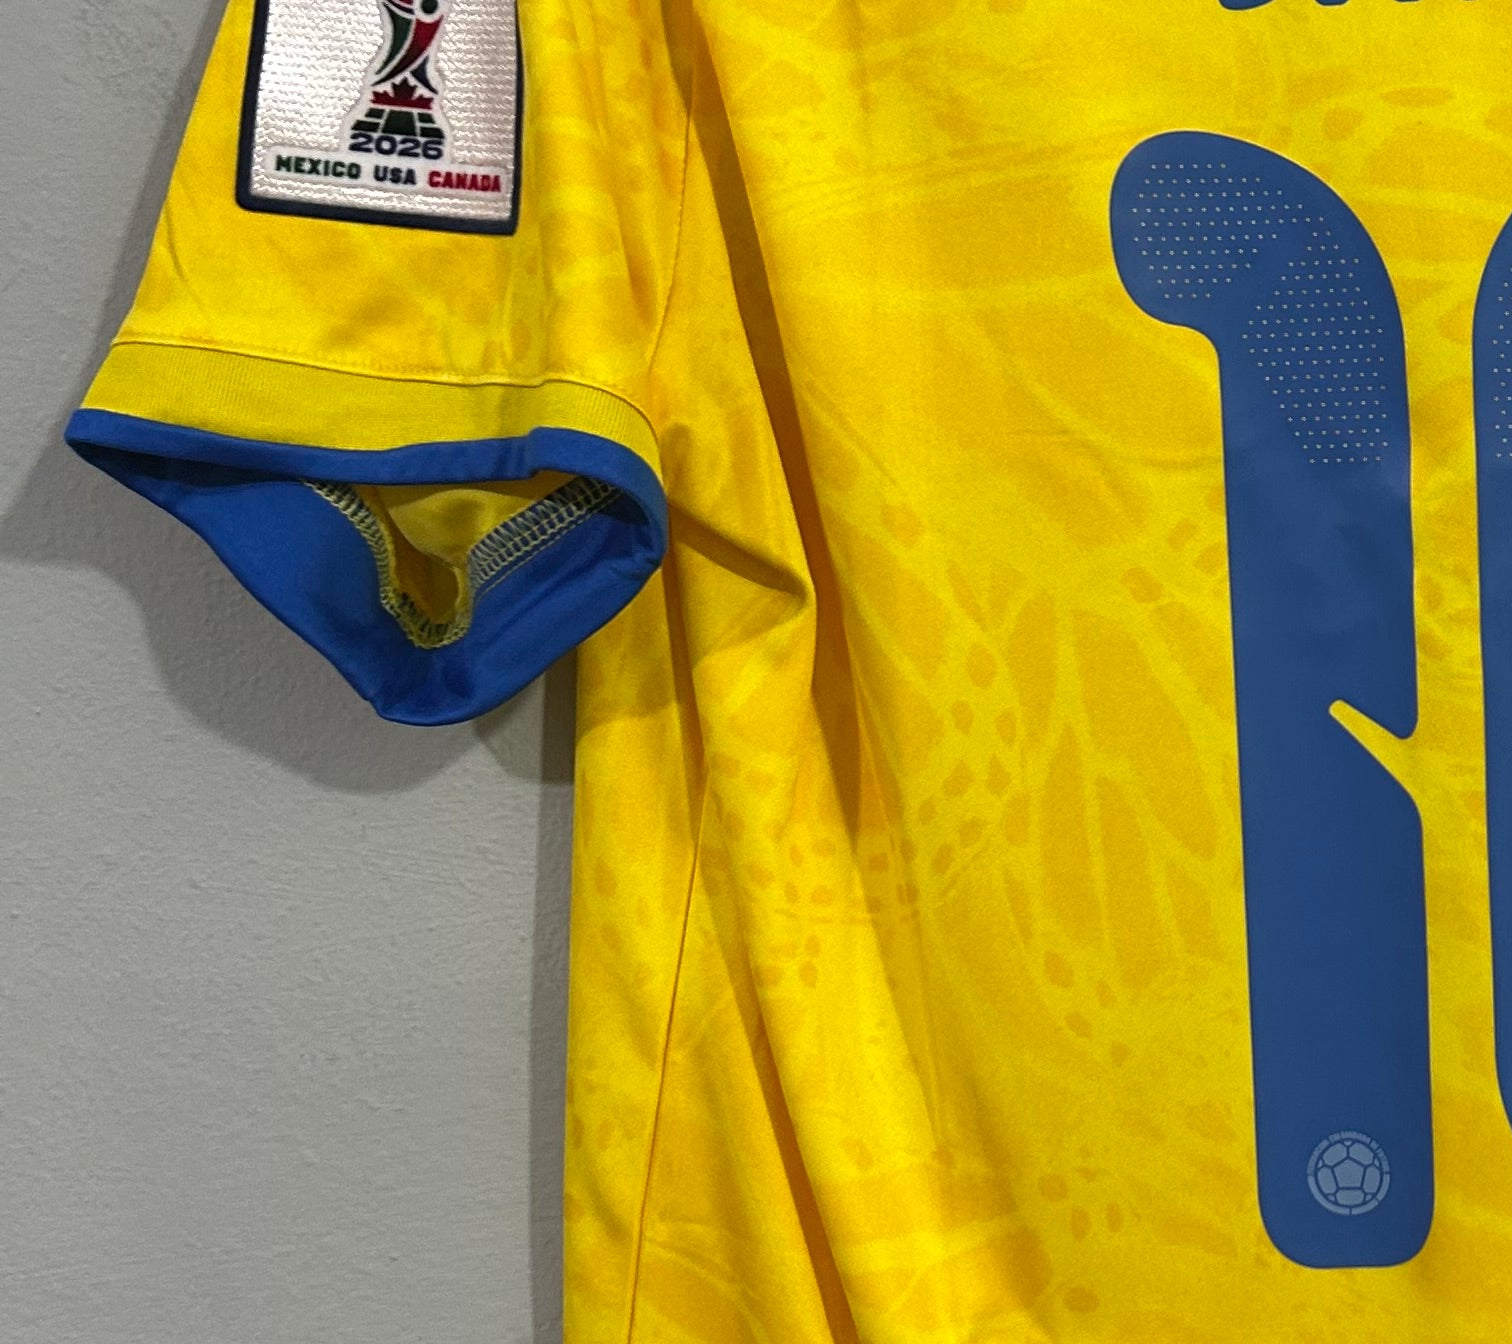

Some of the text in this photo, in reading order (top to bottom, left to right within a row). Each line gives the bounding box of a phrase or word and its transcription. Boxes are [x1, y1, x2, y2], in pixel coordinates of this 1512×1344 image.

[348, 132, 445, 160] 2026
[275, 154, 501, 193] MEXICO USA CANADA
